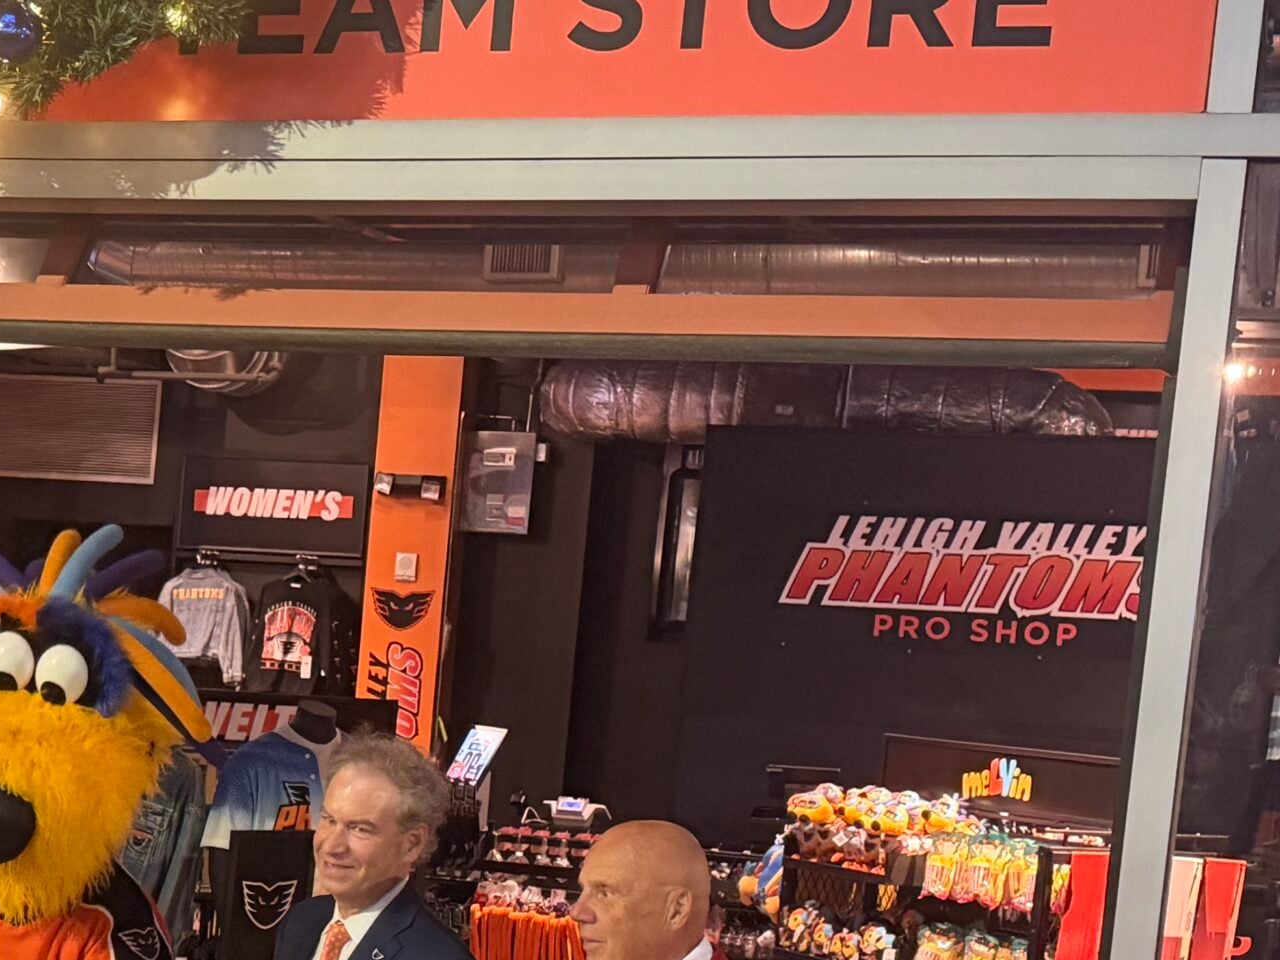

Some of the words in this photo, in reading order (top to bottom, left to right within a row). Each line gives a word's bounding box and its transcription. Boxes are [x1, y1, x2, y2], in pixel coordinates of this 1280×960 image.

[177, 0, 512, 55] EAM
[205, 486, 343, 521] WOMEN'S
[826, 515, 987, 550] LEHIGH
[996, 521, 1148, 557] VALLEY
[873, 614, 951, 641] PRO
[970, 618, 1078, 646] SHOP
